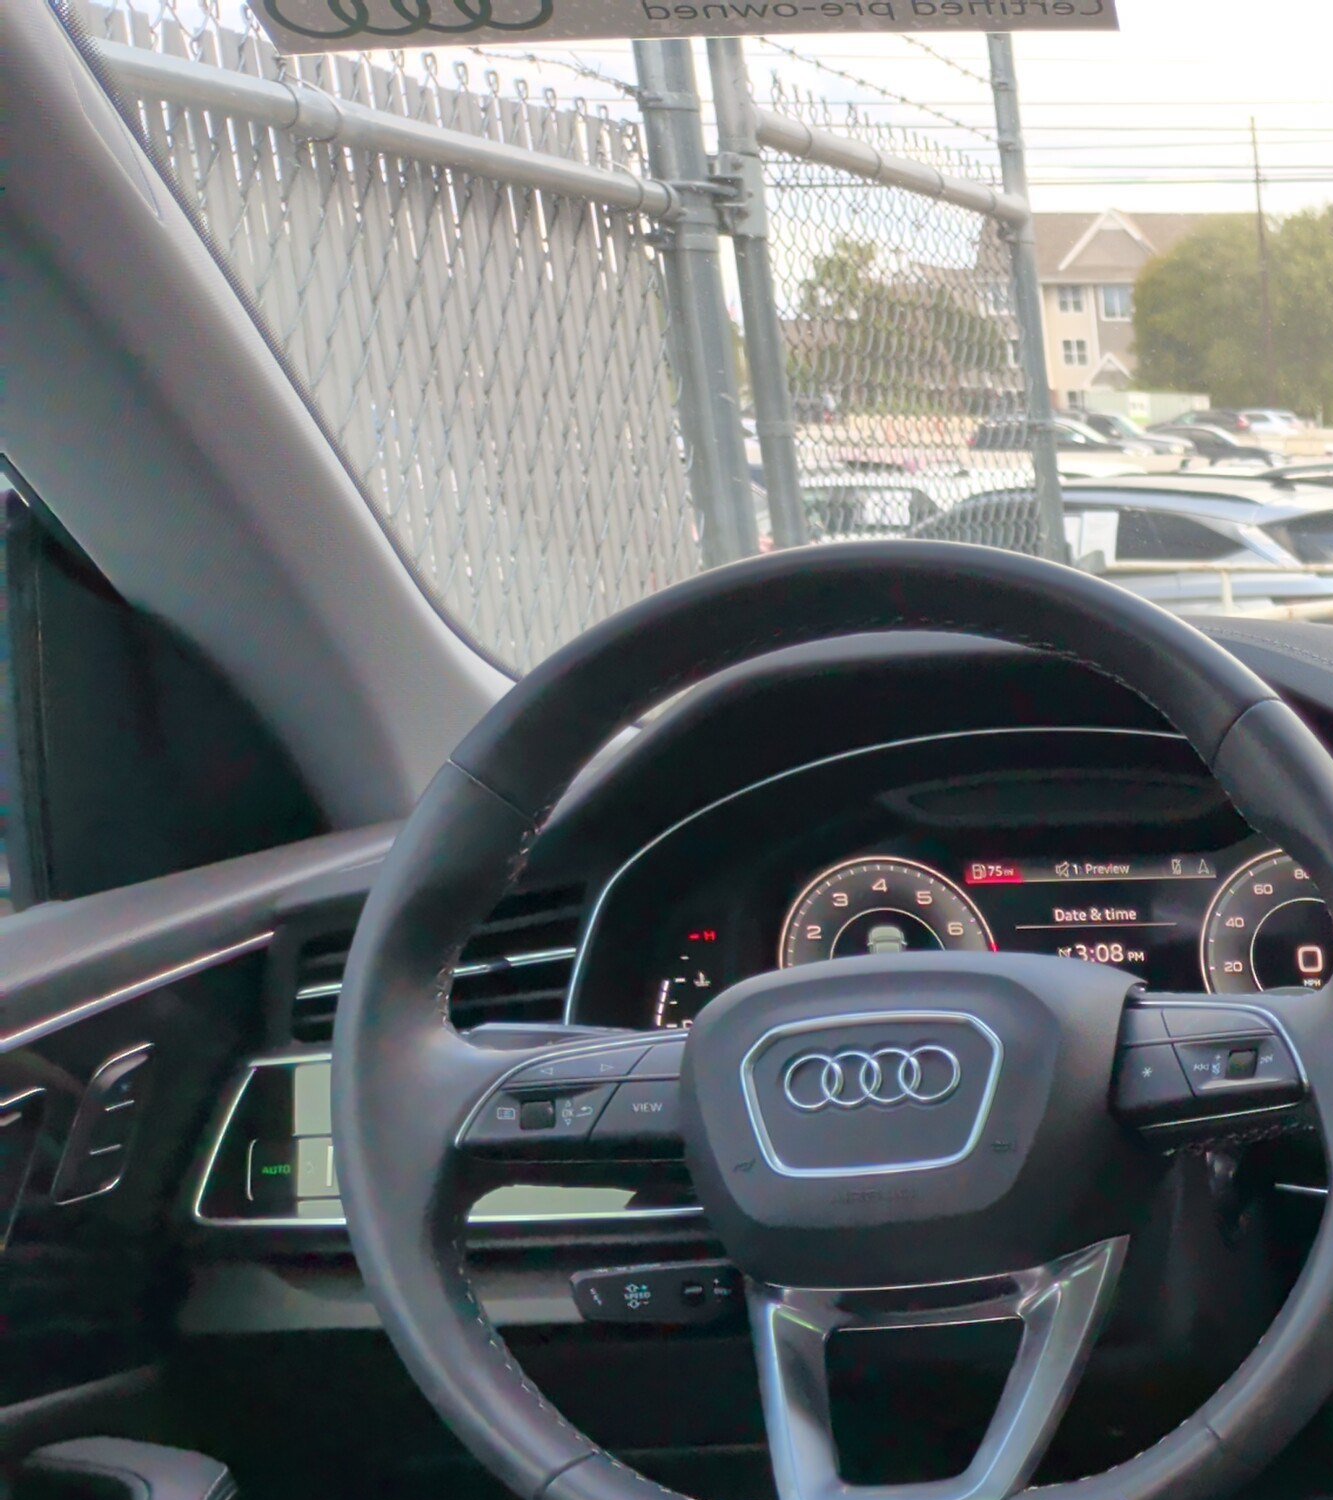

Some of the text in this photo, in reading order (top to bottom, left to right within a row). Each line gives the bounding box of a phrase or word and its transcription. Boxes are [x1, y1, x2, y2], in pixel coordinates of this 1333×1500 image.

[988, 865, 1002, 876] 75
[1085, 862, 1130, 875] Preview
[872, 879, 888, 892] 4
[1254, 884, 1274, 895] 60
[833, 893, 849, 907] 3
[917, 891, 933, 905] 5
[1054, 908, 1137, 921] Date & time
[947, 922, 964, 936] 6
[1225, 917, 1245, 928] 40
[806, 925, 821, 939] 2
[1075, 944, 1145, 963] 3:08 PM
[1297, 946, 1323, 973] 0
[1224, 962, 1243, 973] 20
[1303, 978, 1321, 987] MPH
[632, 1102, 663, 1113] VIEW
[262, 1164, 291, 1175] AUTO
